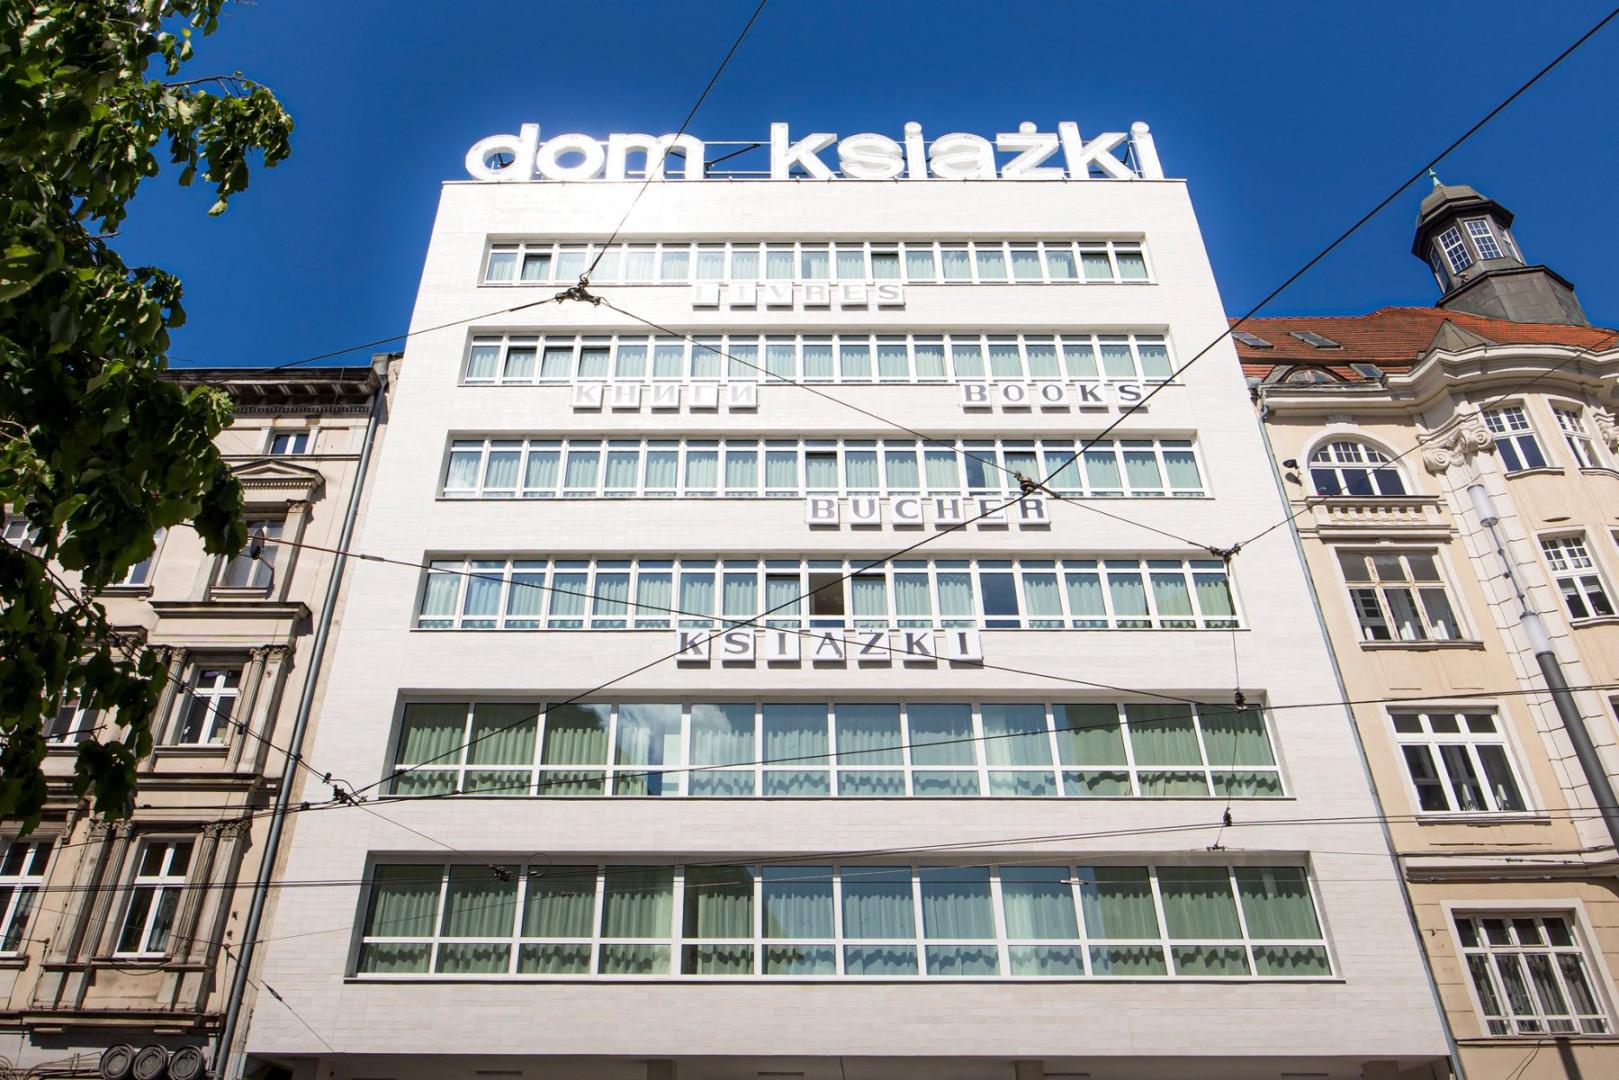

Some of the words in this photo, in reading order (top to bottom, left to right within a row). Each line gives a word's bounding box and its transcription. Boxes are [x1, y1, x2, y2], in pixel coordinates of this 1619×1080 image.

[465, 123, 705, 180] dom
[694, 284, 900, 301] LIVRES
[575, 384, 753, 403] КНИГИ
[963, 384, 1143, 402] BOOKS
